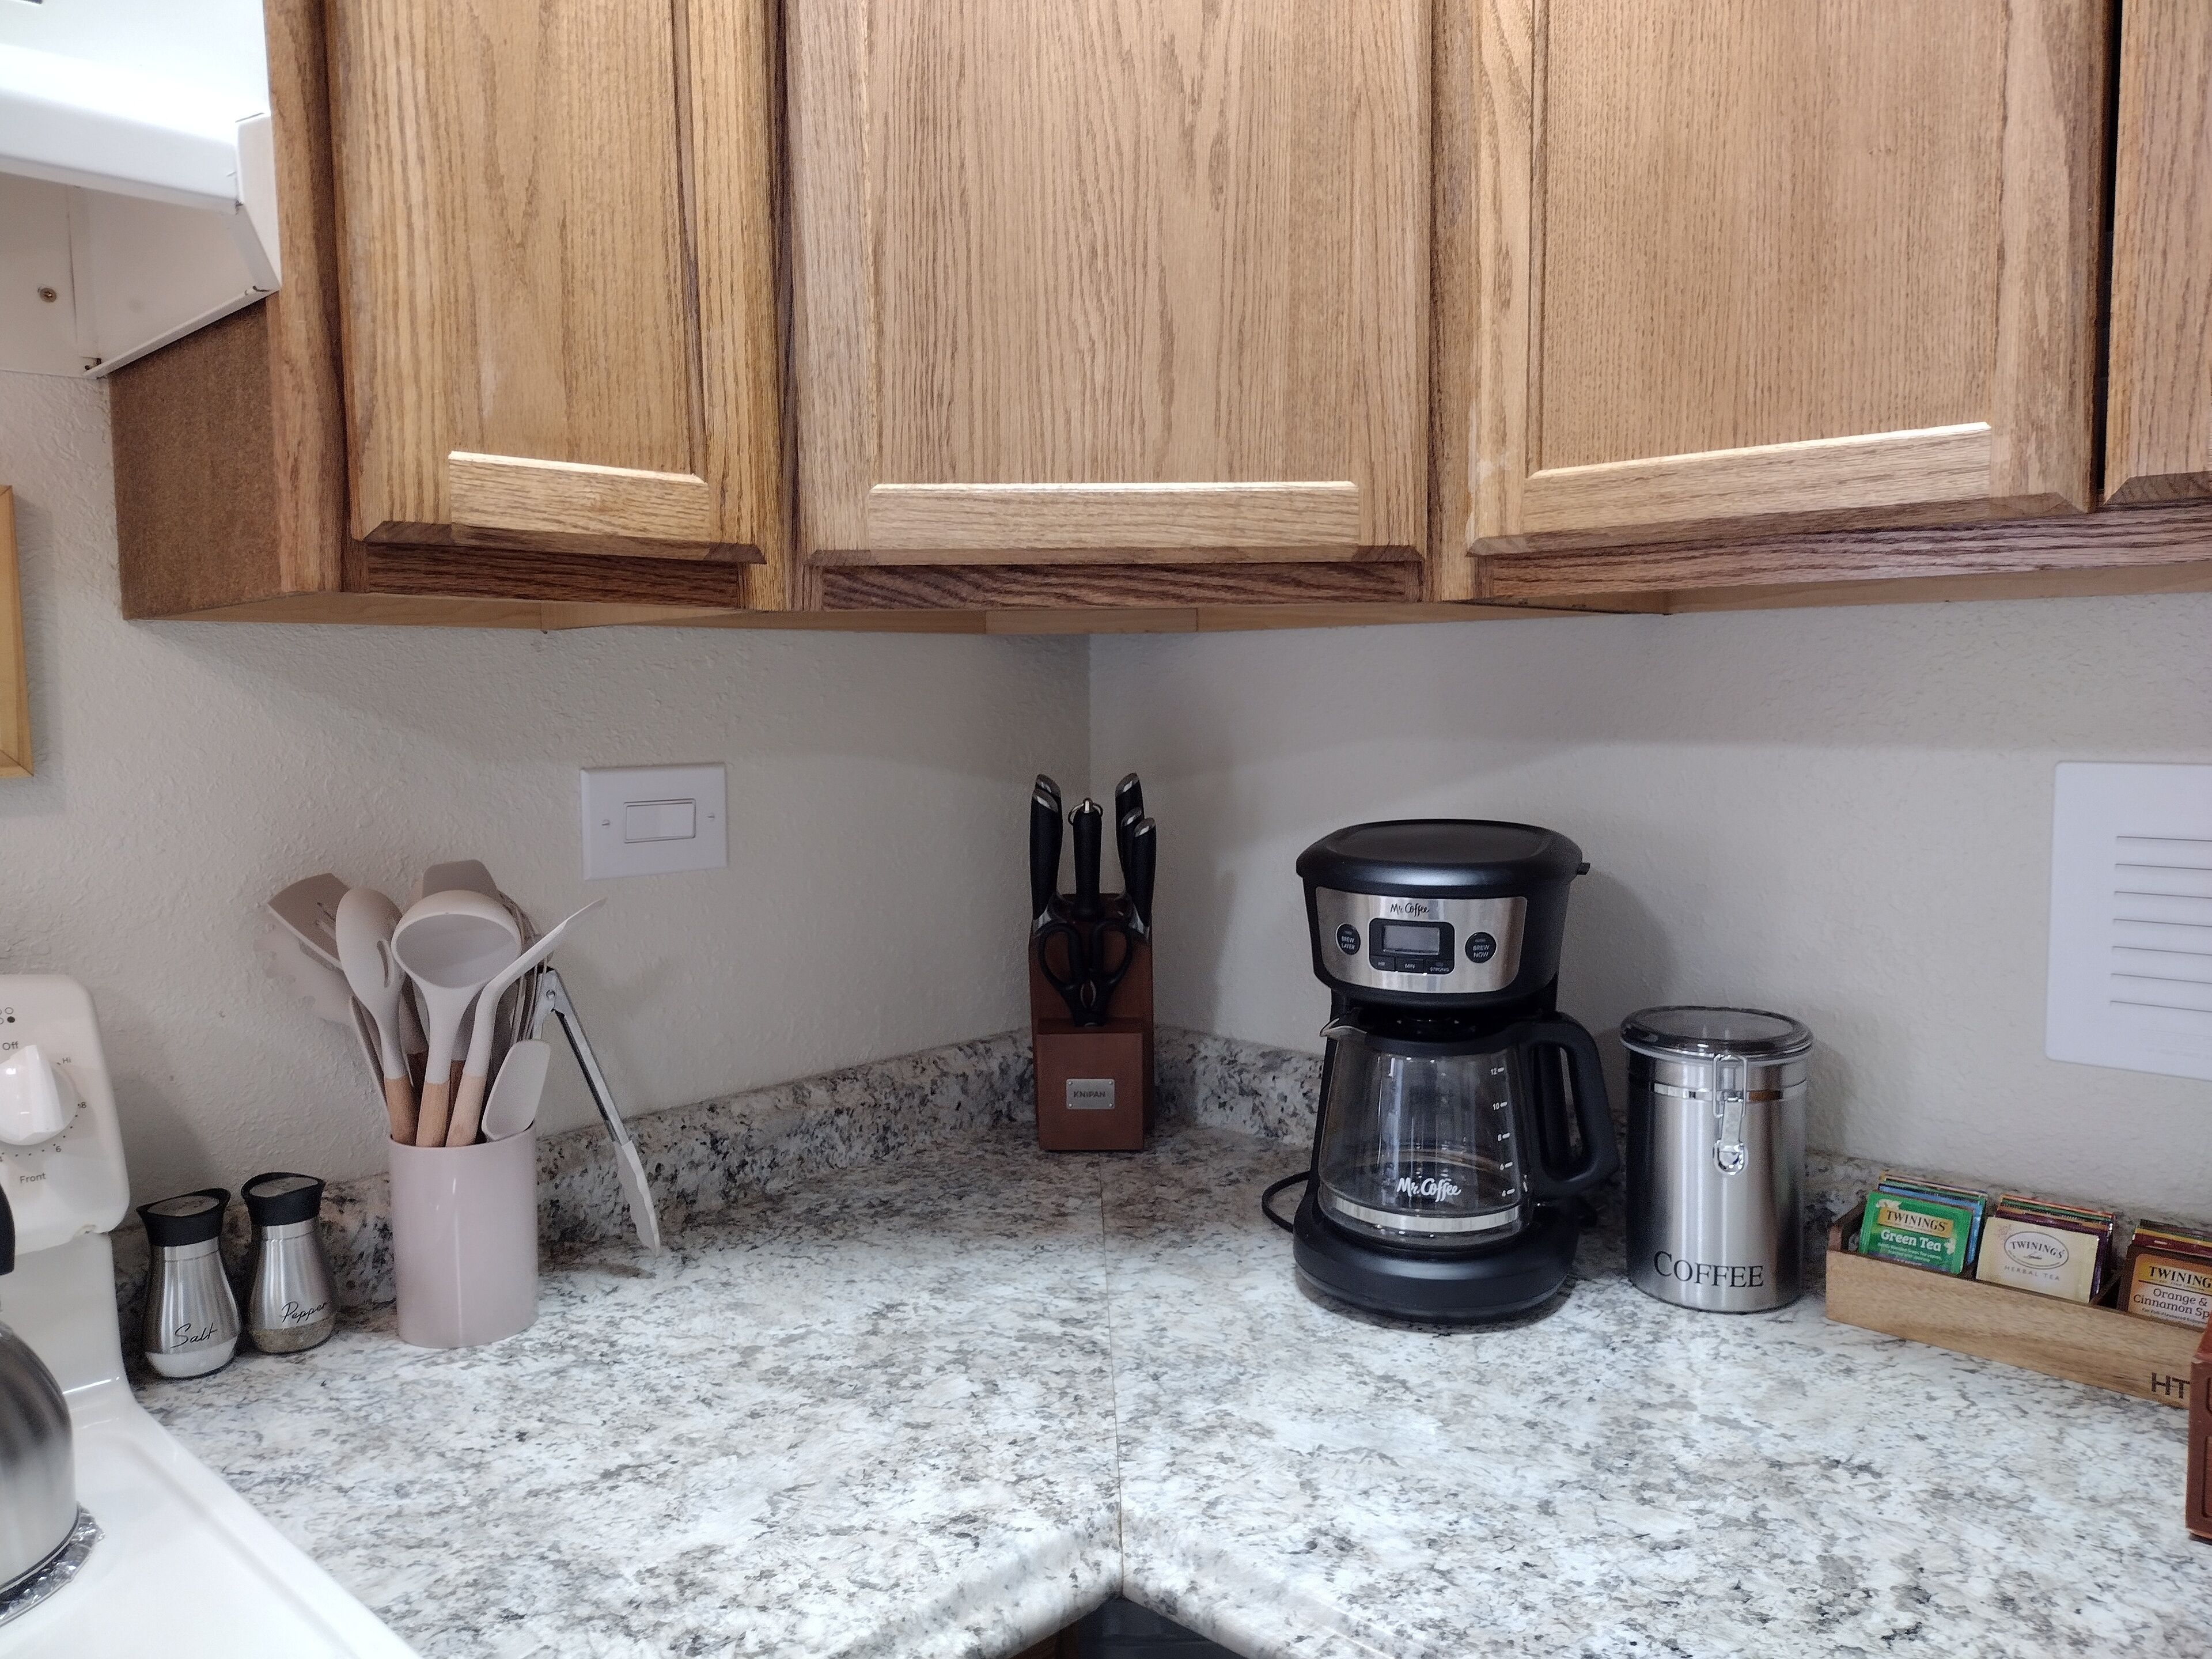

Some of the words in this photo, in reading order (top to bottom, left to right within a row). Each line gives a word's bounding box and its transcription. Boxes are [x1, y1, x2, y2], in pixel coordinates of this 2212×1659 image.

[1404, 902, 1430, 917] Coffee
[2, 1041, 19, 1051] Off
[1493, 1103, 1499, 1111] 10
[1499, 1163, 1505, 1171] 6
[20, 1173, 46, 1183] Front
[1421, 1177, 1461, 1202] Coffee
[1501, 1190, 1507, 1198] 4
[1887, 1210, 1946, 1233] TWININGS
[1881, 1229, 1917, 1246] Green
[1919, 1237, 1941, 1252] Tea
[2009, 1241, 2065, 1259] TWININGS
[1653, 1250, 1764, 1287] COFFEE
[2004, 1265, 2039, 1277] HERBAL
[2044, 1272, 2061, 1282] TEA
[2149, 1266, 2212, 1289] TWINING
[2133, 1294, 2193, 1315] Cinnamon
[2153, 1288, 2196, 1305] Orange
[2198, 1297, 2208, 1307] &
[281, 1301, 329, 1323] Pepper
[169, 1322, 218, 1349] Salt
